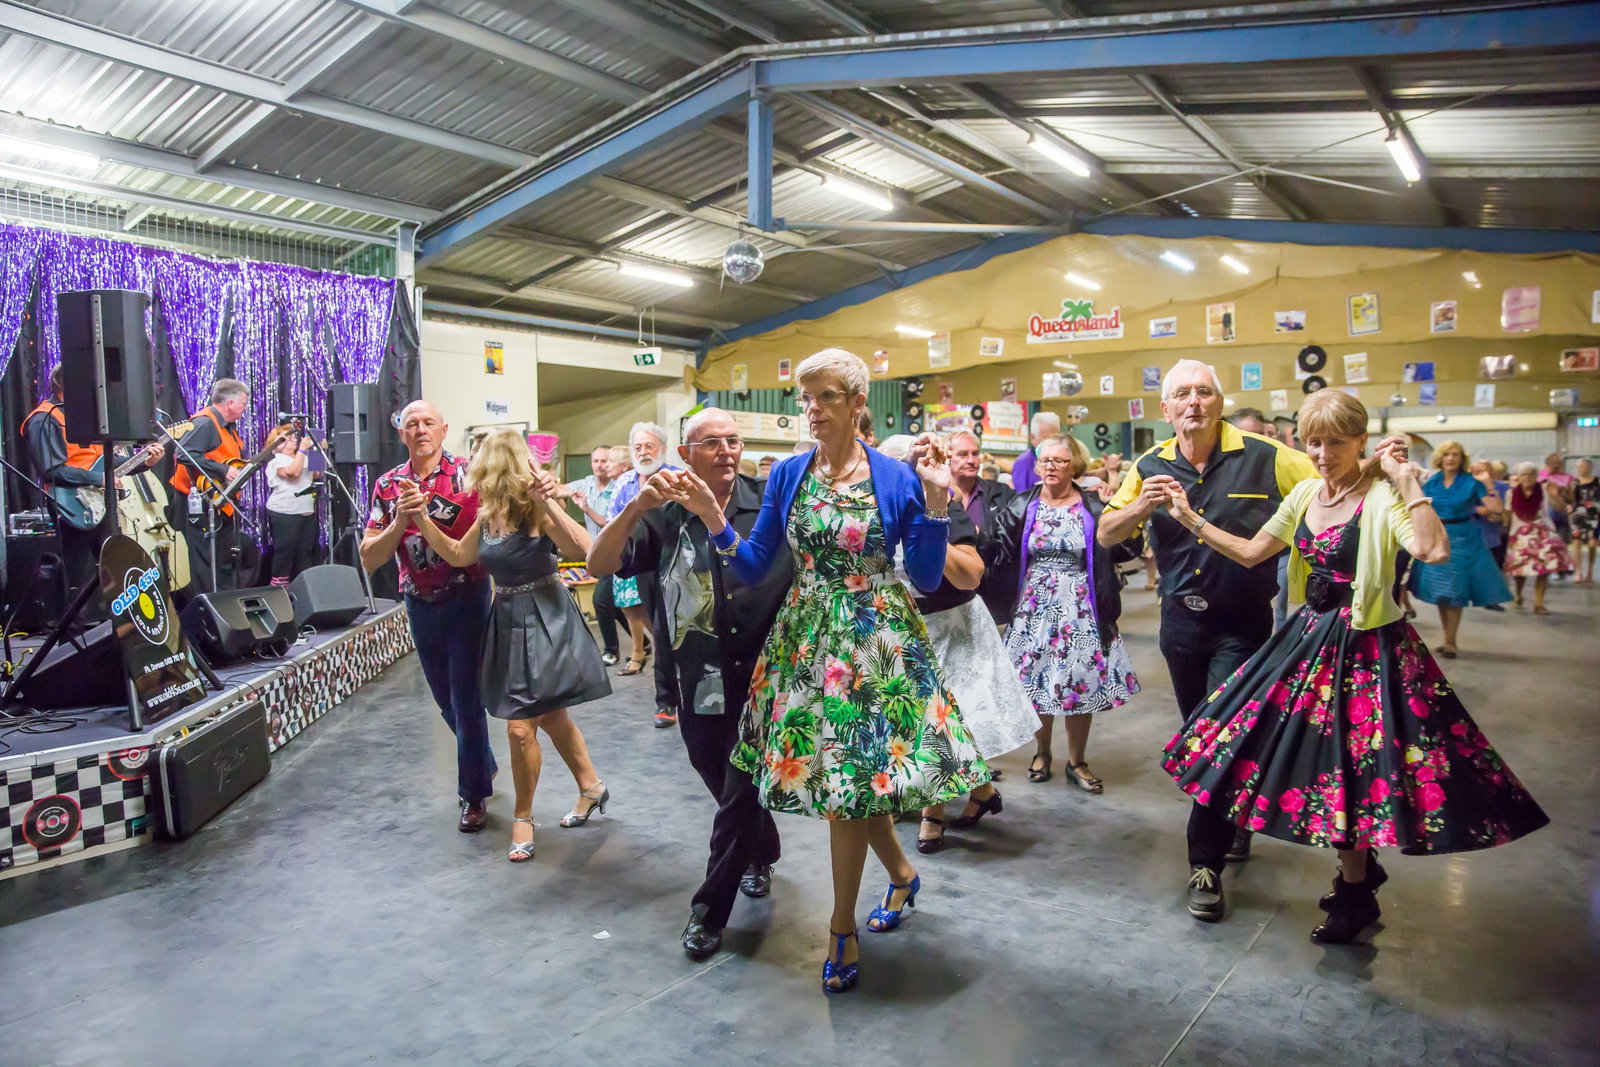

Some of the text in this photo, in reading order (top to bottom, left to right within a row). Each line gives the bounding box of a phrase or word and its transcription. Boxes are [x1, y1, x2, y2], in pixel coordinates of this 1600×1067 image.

[1030, 309, 1120, 337] Queensland
[486, 400, 508, 416] Widgees
[111, 567, 160, 616] OLD 45's
